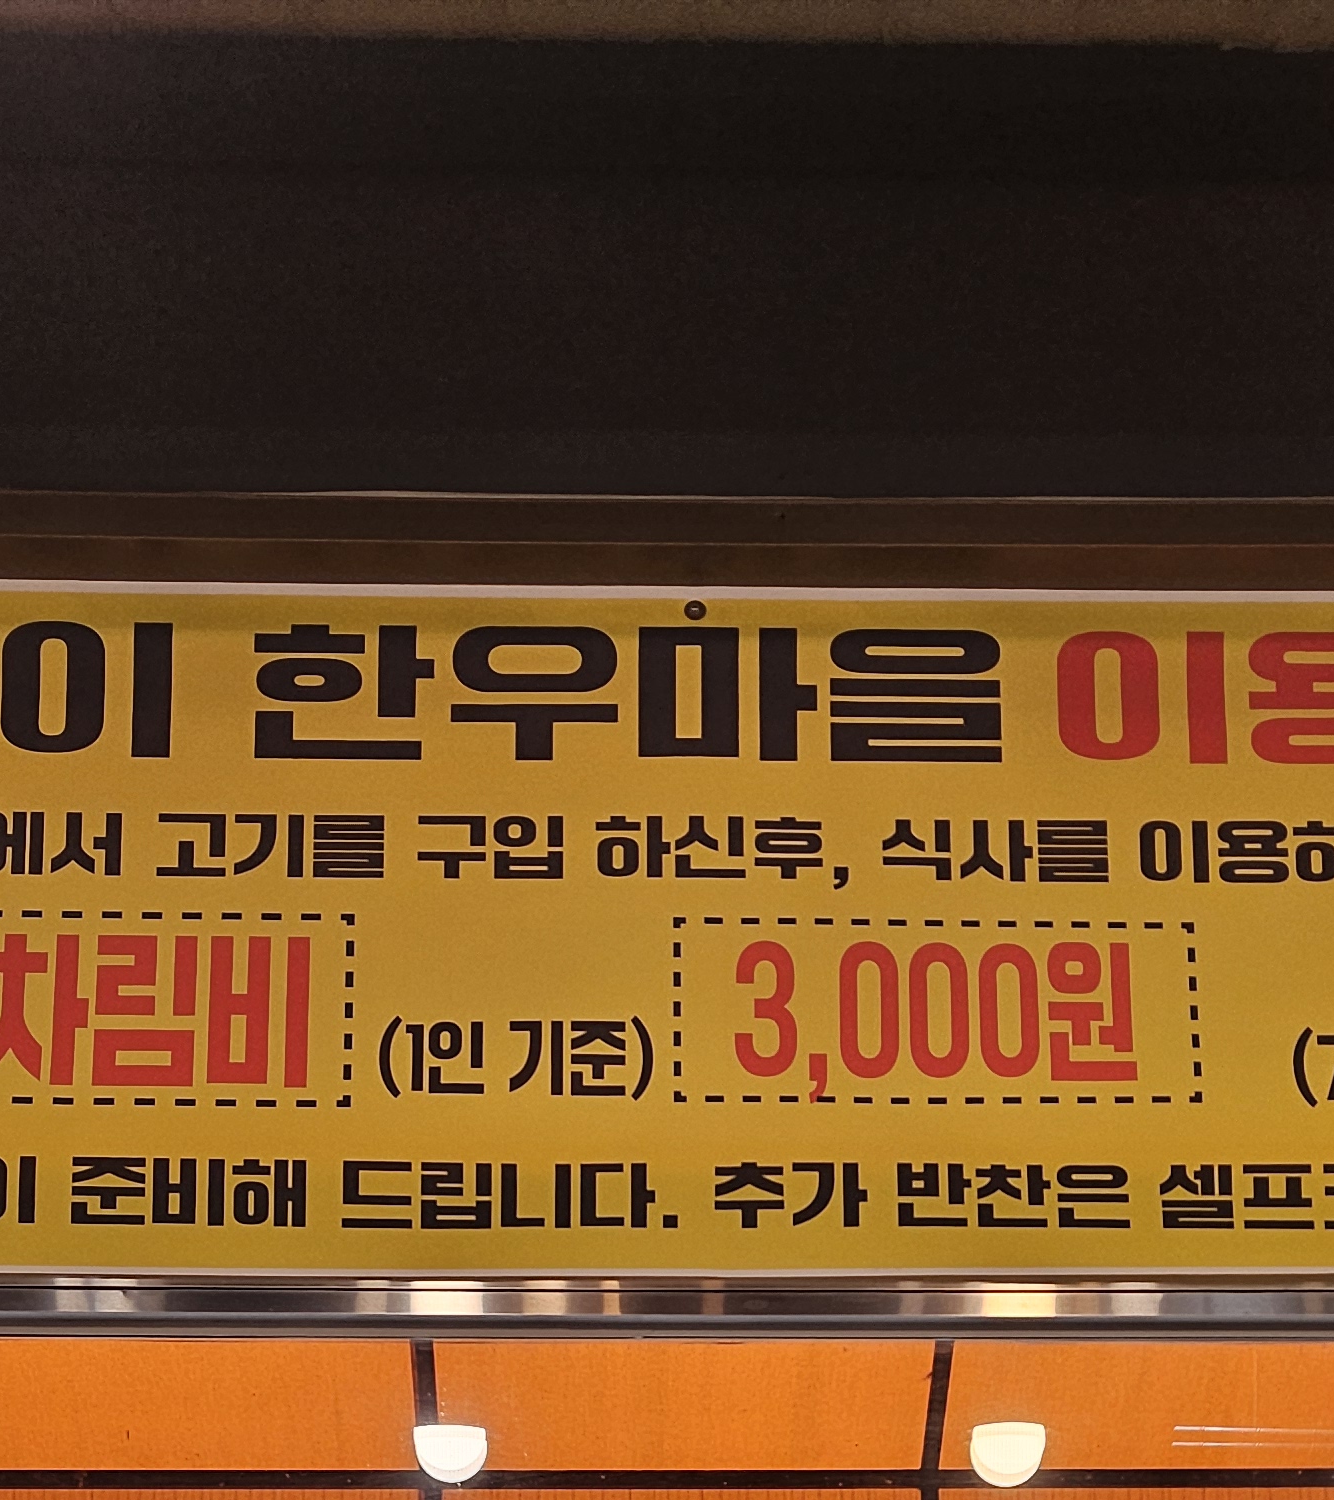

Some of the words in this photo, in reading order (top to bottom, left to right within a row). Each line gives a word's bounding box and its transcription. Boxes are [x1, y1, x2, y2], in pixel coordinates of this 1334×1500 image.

[254, 623, 1003, 763] 한우마을
[156, 813, 385, 879] 고기를
[417, 815, 564, 880] 구입
[595, 815, 849, 890] 하신후,
[882, 819, 1109, 883] 식사를
[378, 1015, 485, 1098] (1인
[509, 1015, 654, 1101] 기준)
[734, 940, 1139, 1104] 3,000원
[70, 1156, 307, 1228] 준비해
[341, 1160, 679, 1230] 드립니다.
[714, 1162, 868, 1229] 추가
[896, 1162, 1131, 1229] 반찬은
